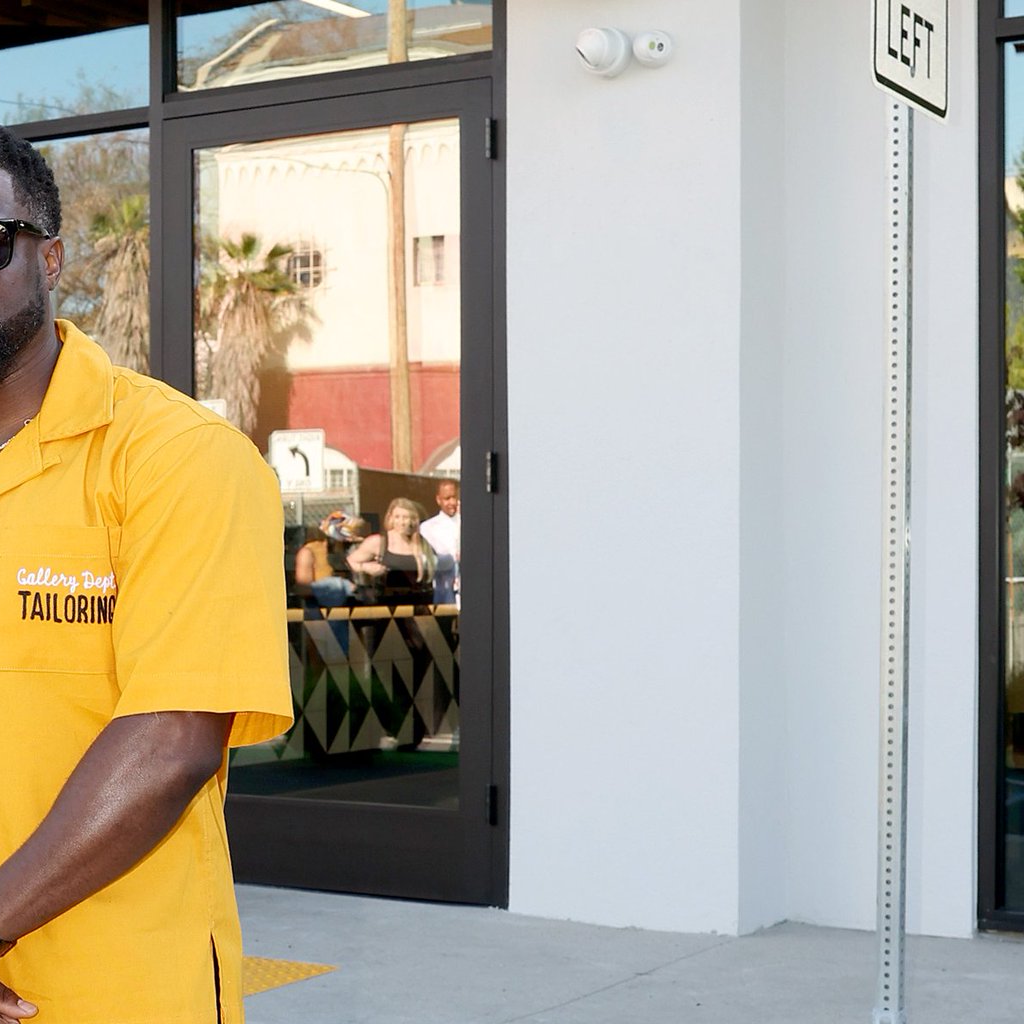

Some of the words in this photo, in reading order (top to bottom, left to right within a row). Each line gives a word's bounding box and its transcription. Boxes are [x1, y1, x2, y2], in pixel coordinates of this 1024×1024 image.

[888, 0, 934, 79] LEFT
[17, 567, 79, 593] Gallery
[18, 590, 116, 624] TAILORING
